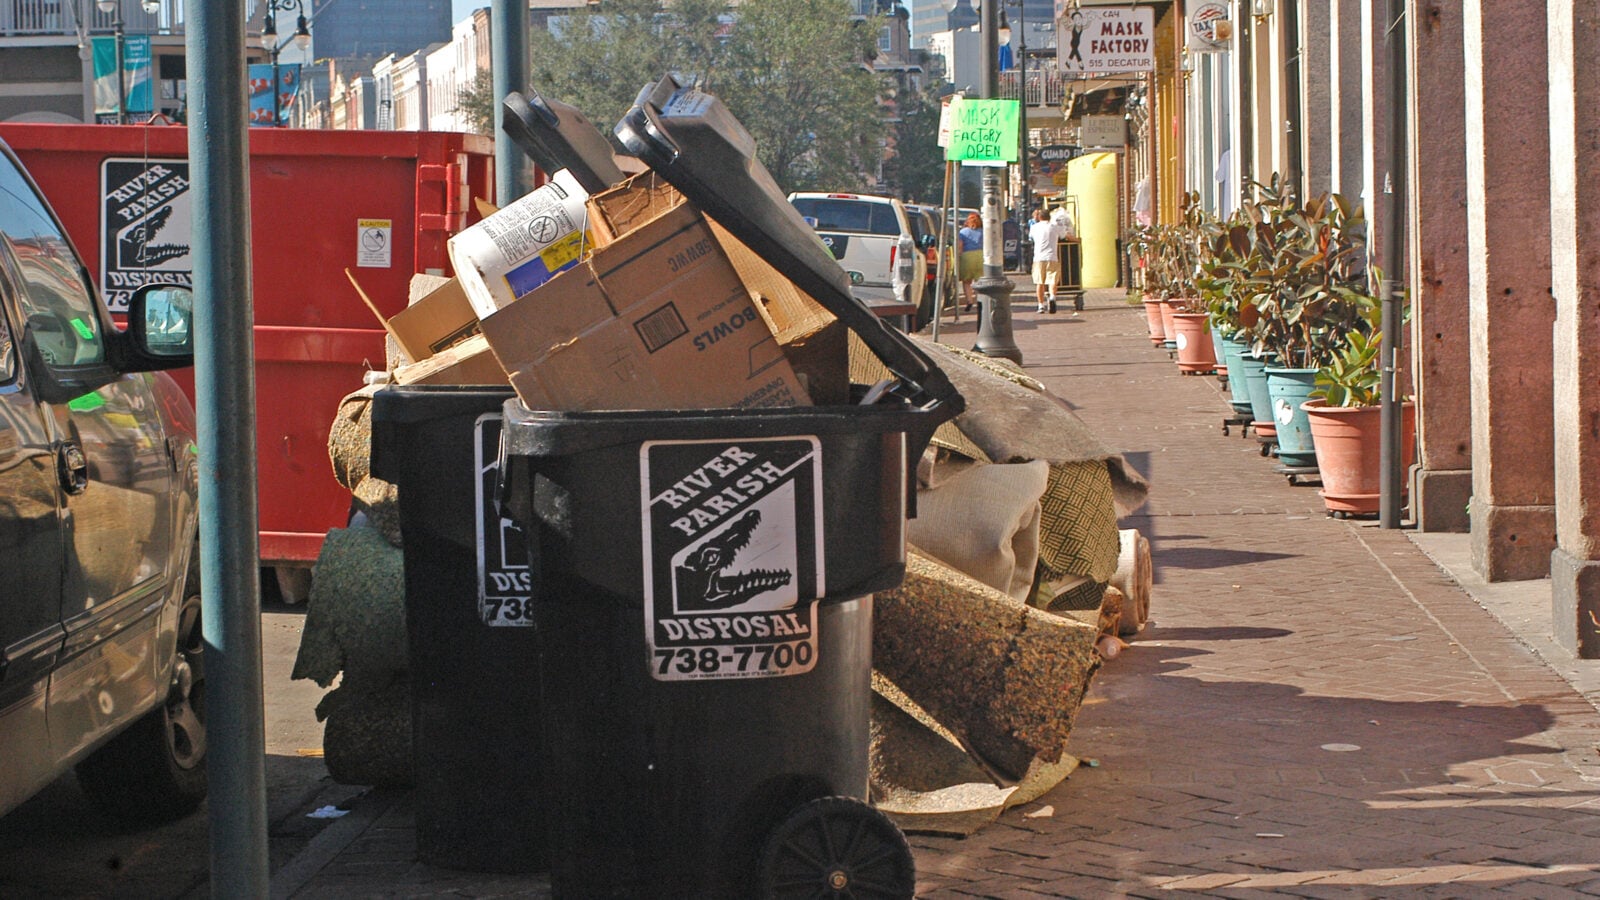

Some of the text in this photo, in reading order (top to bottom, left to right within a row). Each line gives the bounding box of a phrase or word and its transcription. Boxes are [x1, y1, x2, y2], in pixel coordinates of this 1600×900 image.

[1100, 22, 1143, 36] MASK
[1091, 39, 1149, 54] FACTORY
[1107, 59, 1151, 67] DECATUR
[957, 106, 1000, 127] MASK
[953, 128, 1002, 144] FACTORY
[966, 143, 1000, 159] OPEN
[1041, 149, 1070, 159] GUMBO
[111, 164, 172, 203] RIVER
[116, 175, 189, 221] PARISH
[108, 271, 192, 288] DISPOSA
[692, 306, 757, 351] BOWLS
[659, 446, 758, 509] RIVER
[669, 460, 783, 536] PARISH
[658, 613, 809, 641] DISPOSAL
[654, 641, 812, 674] 738-7700
